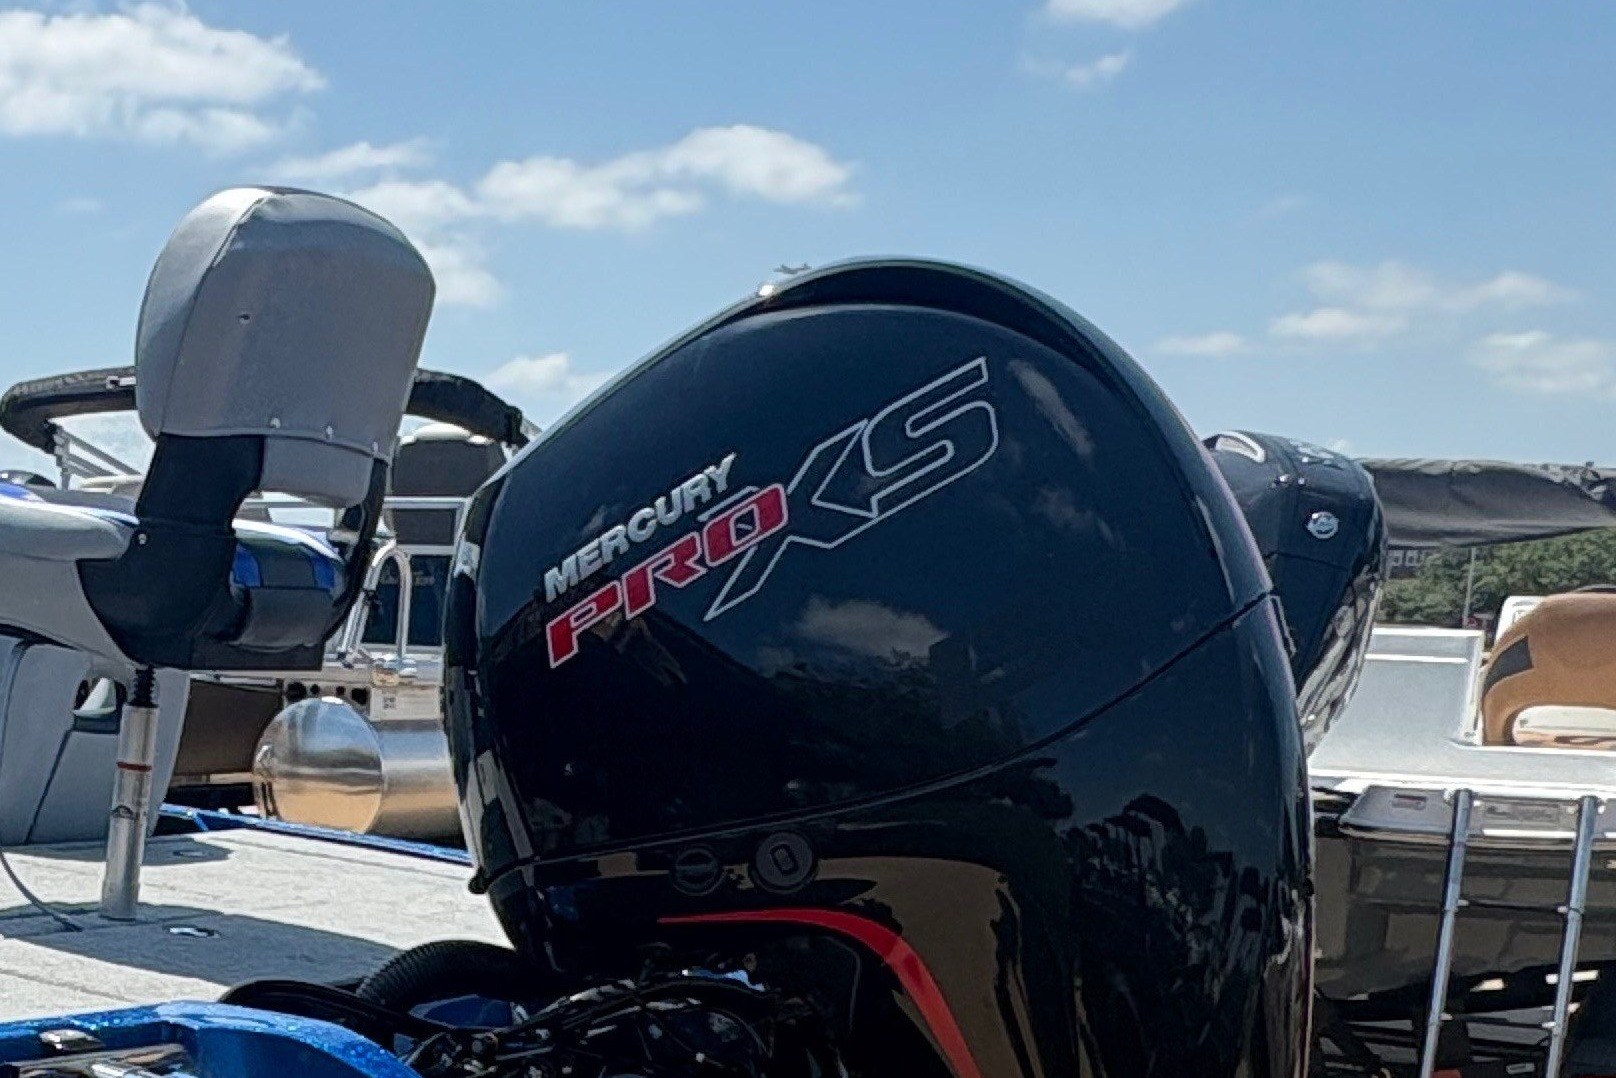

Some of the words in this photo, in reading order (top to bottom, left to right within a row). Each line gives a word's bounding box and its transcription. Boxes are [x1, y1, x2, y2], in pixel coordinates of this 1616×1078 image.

[543, 451, 737, 602] MERCURY
[545, 483, 788, 669] PRO
[697, 356, 999, 622] XS
